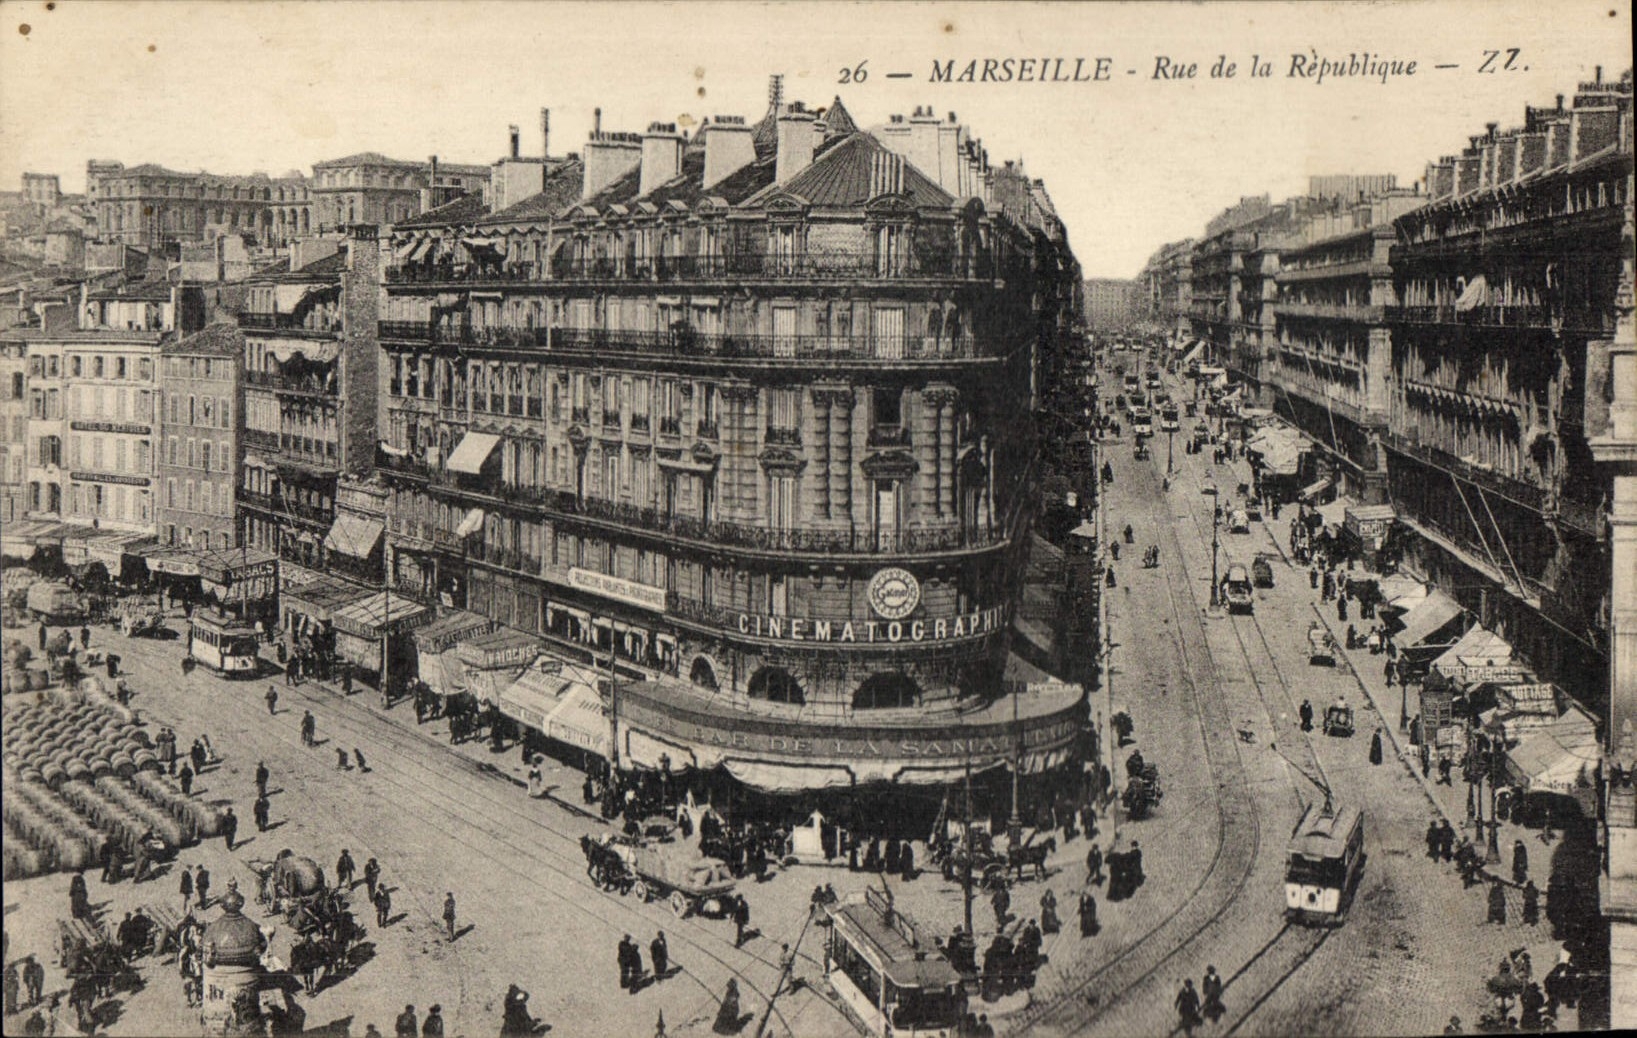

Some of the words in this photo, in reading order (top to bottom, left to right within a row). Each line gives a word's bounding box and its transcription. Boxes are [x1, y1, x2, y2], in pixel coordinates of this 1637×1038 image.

[693, 727, 748, 746] BAR
[769, 738, 811, 752] DE
[834, 740, 881, 755] LA
